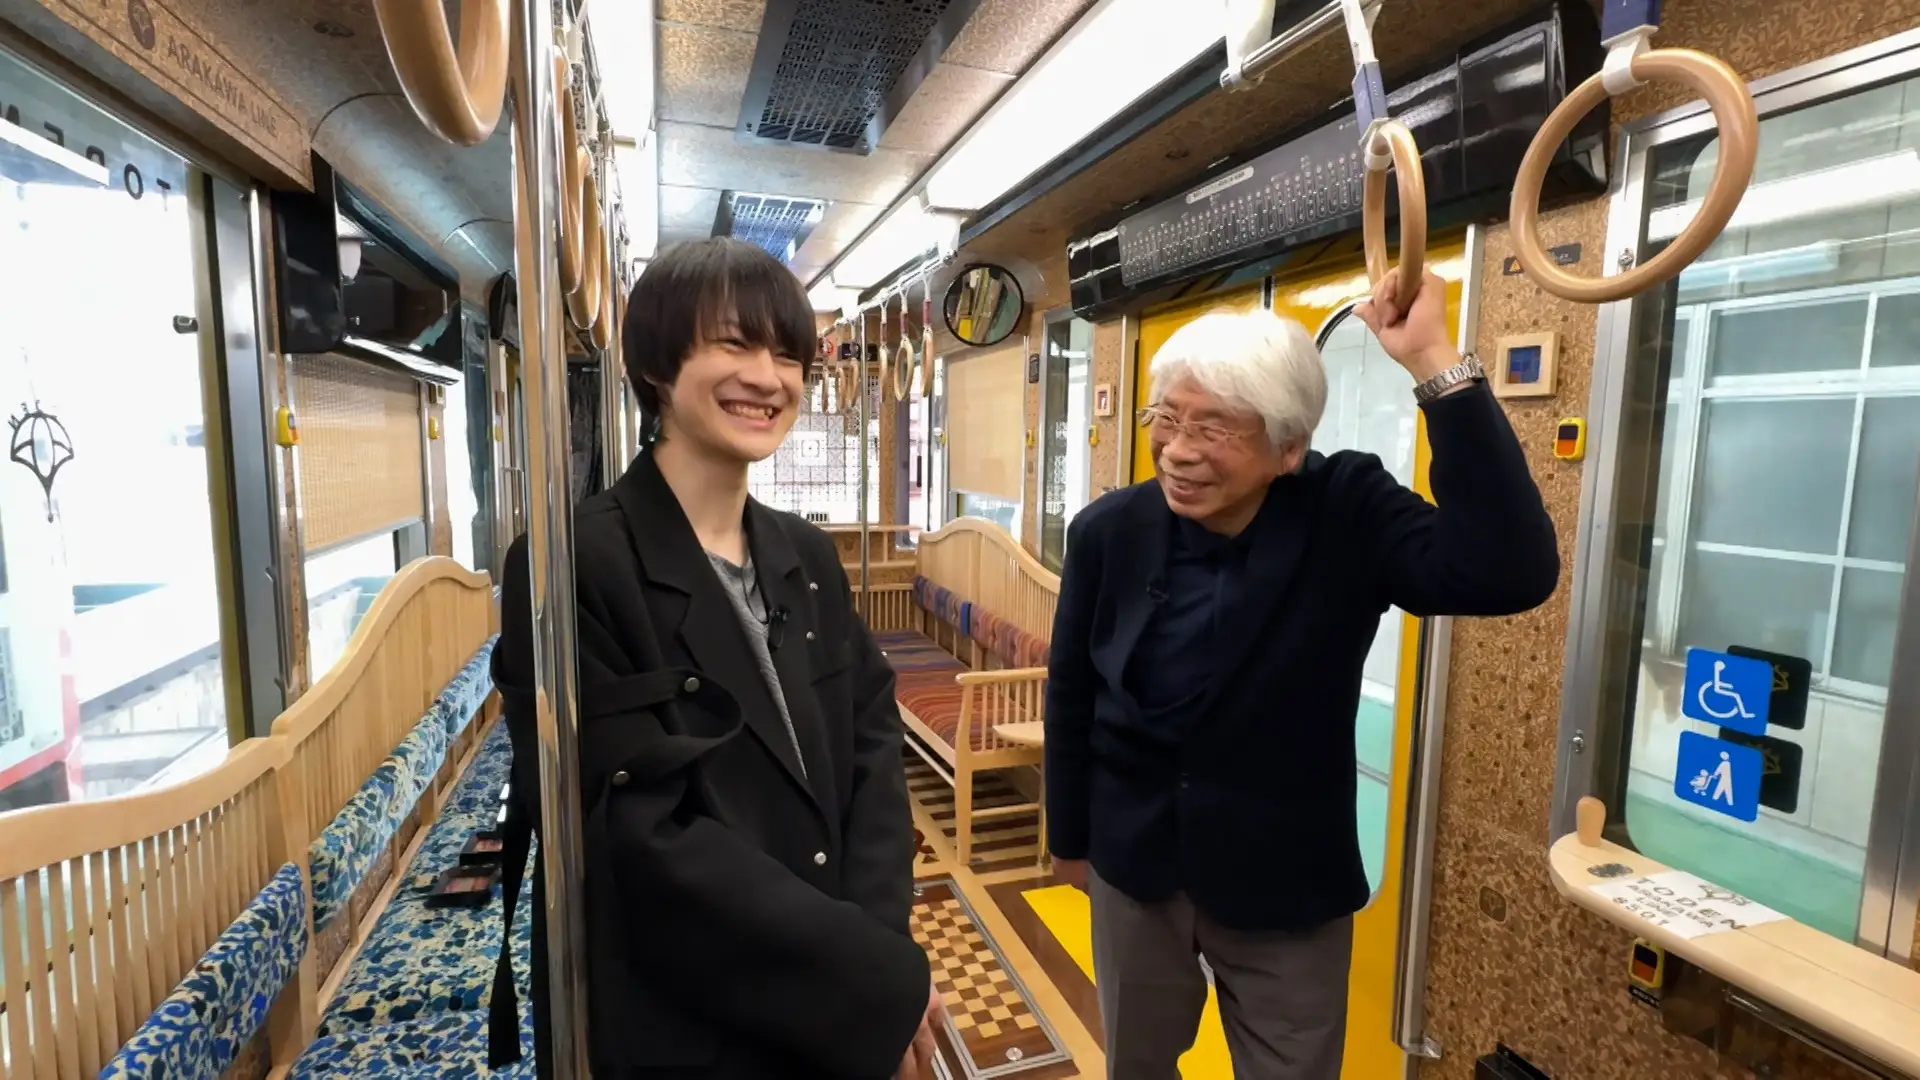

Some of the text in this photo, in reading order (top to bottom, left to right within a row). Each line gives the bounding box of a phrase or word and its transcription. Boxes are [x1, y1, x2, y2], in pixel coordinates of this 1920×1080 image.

[167, 35, 278, 139] ARAKAWA LINE
[1636, 876, 1747, 931] TODEN
